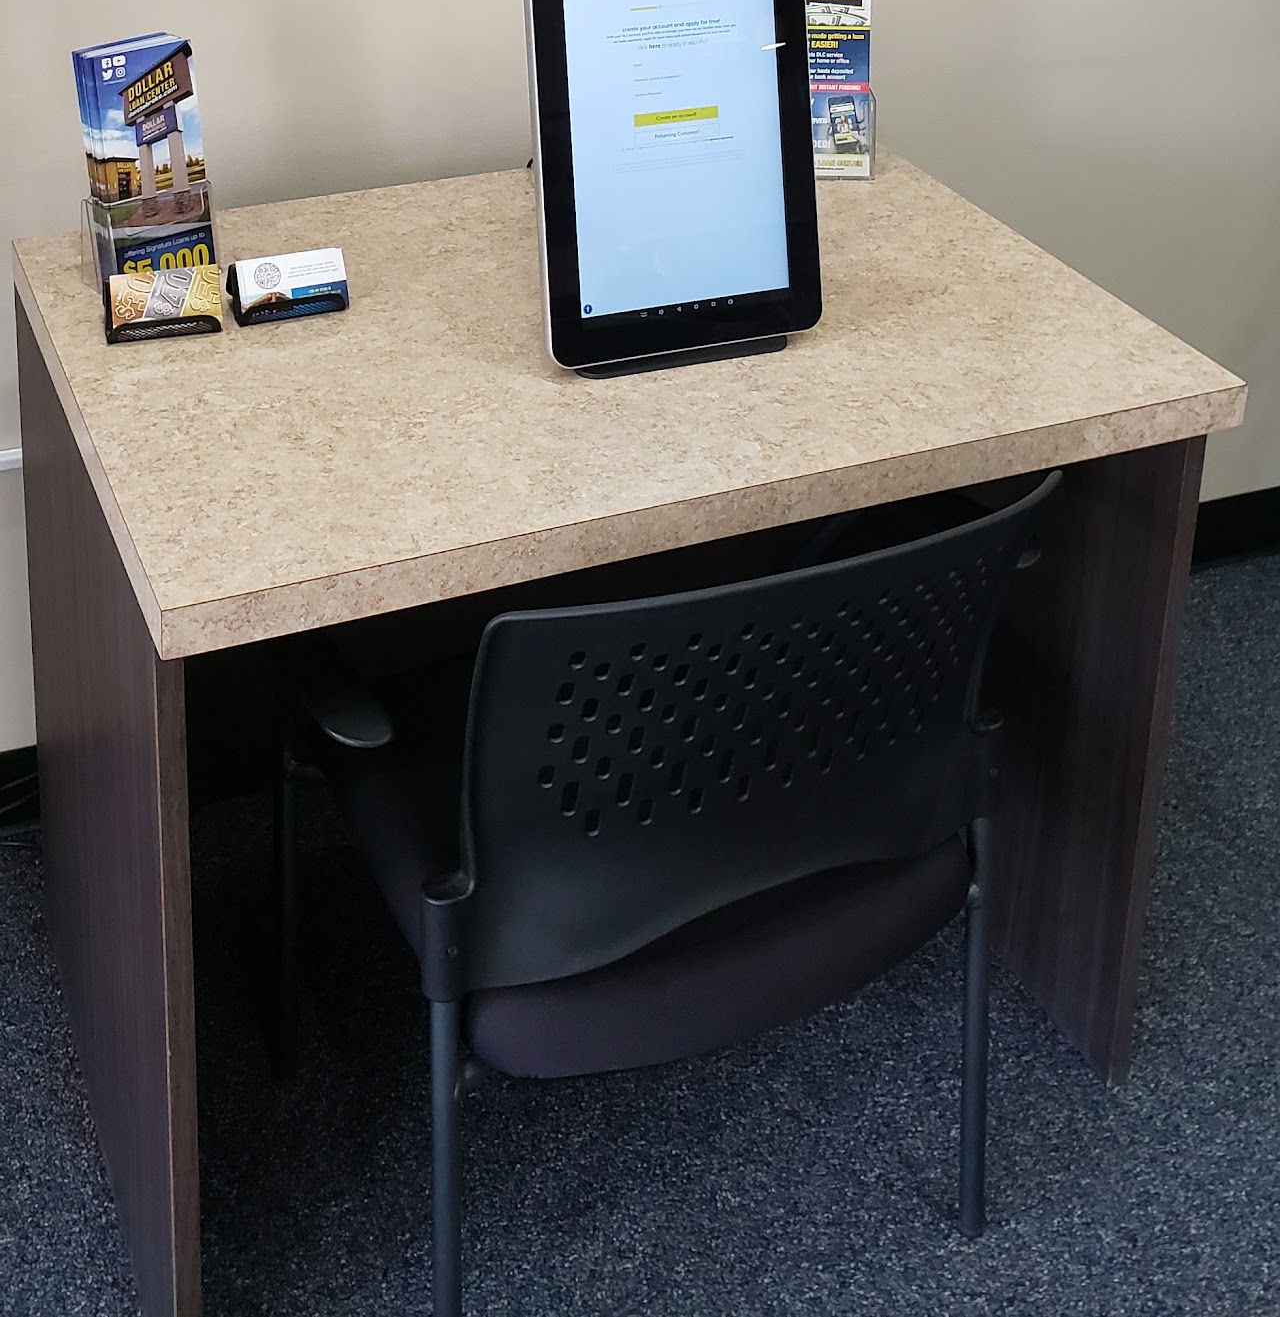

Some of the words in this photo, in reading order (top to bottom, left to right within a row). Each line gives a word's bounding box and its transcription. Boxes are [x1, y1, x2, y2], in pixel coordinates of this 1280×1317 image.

[811, 40, 839, 49] EASIER!
[127, 61, 174, 102] DOLLAR
[129, 96, 145, 112] LOAN
[146, 78, 176, 102] CENTER
[142, 114, 165, 132] DOLLAR
[124, 247, 146, 259] offering
[146, 241, 172, 254] Signature
[173, 236, 190, 246] Loans
[191, 233, 198, 241] up
